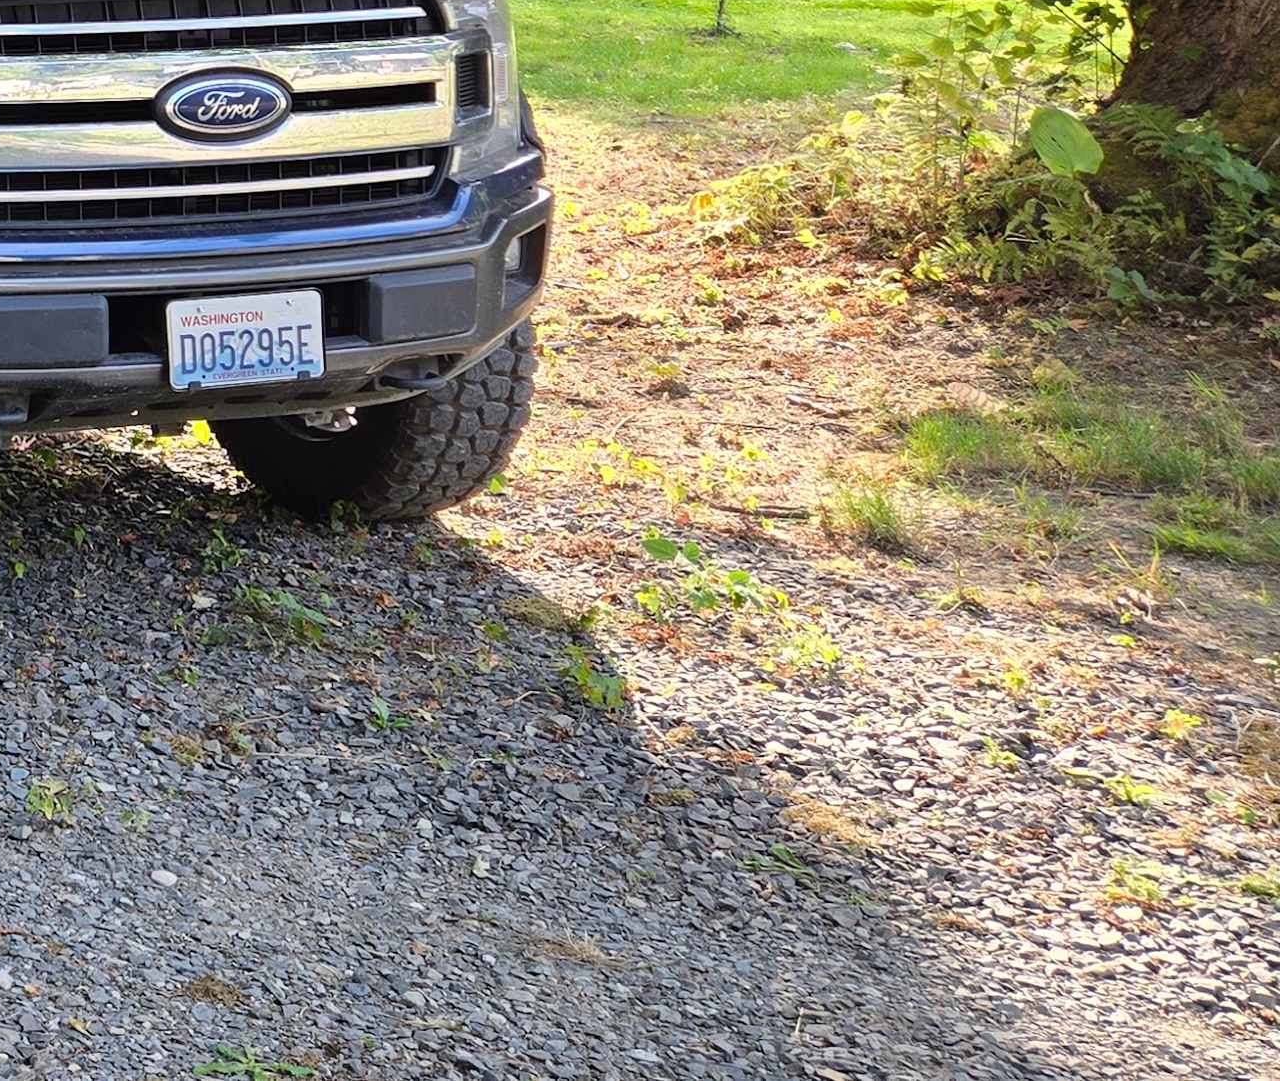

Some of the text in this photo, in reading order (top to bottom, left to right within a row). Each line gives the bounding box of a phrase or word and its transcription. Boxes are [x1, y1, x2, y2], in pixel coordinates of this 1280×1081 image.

[197, 90, 261, 121] Ford
[180, 311, 263, 327] WASHINGTON
[180, 325, 314, 375] D05295E
[212, 368, 283, 380] EVERGREEN STATE
